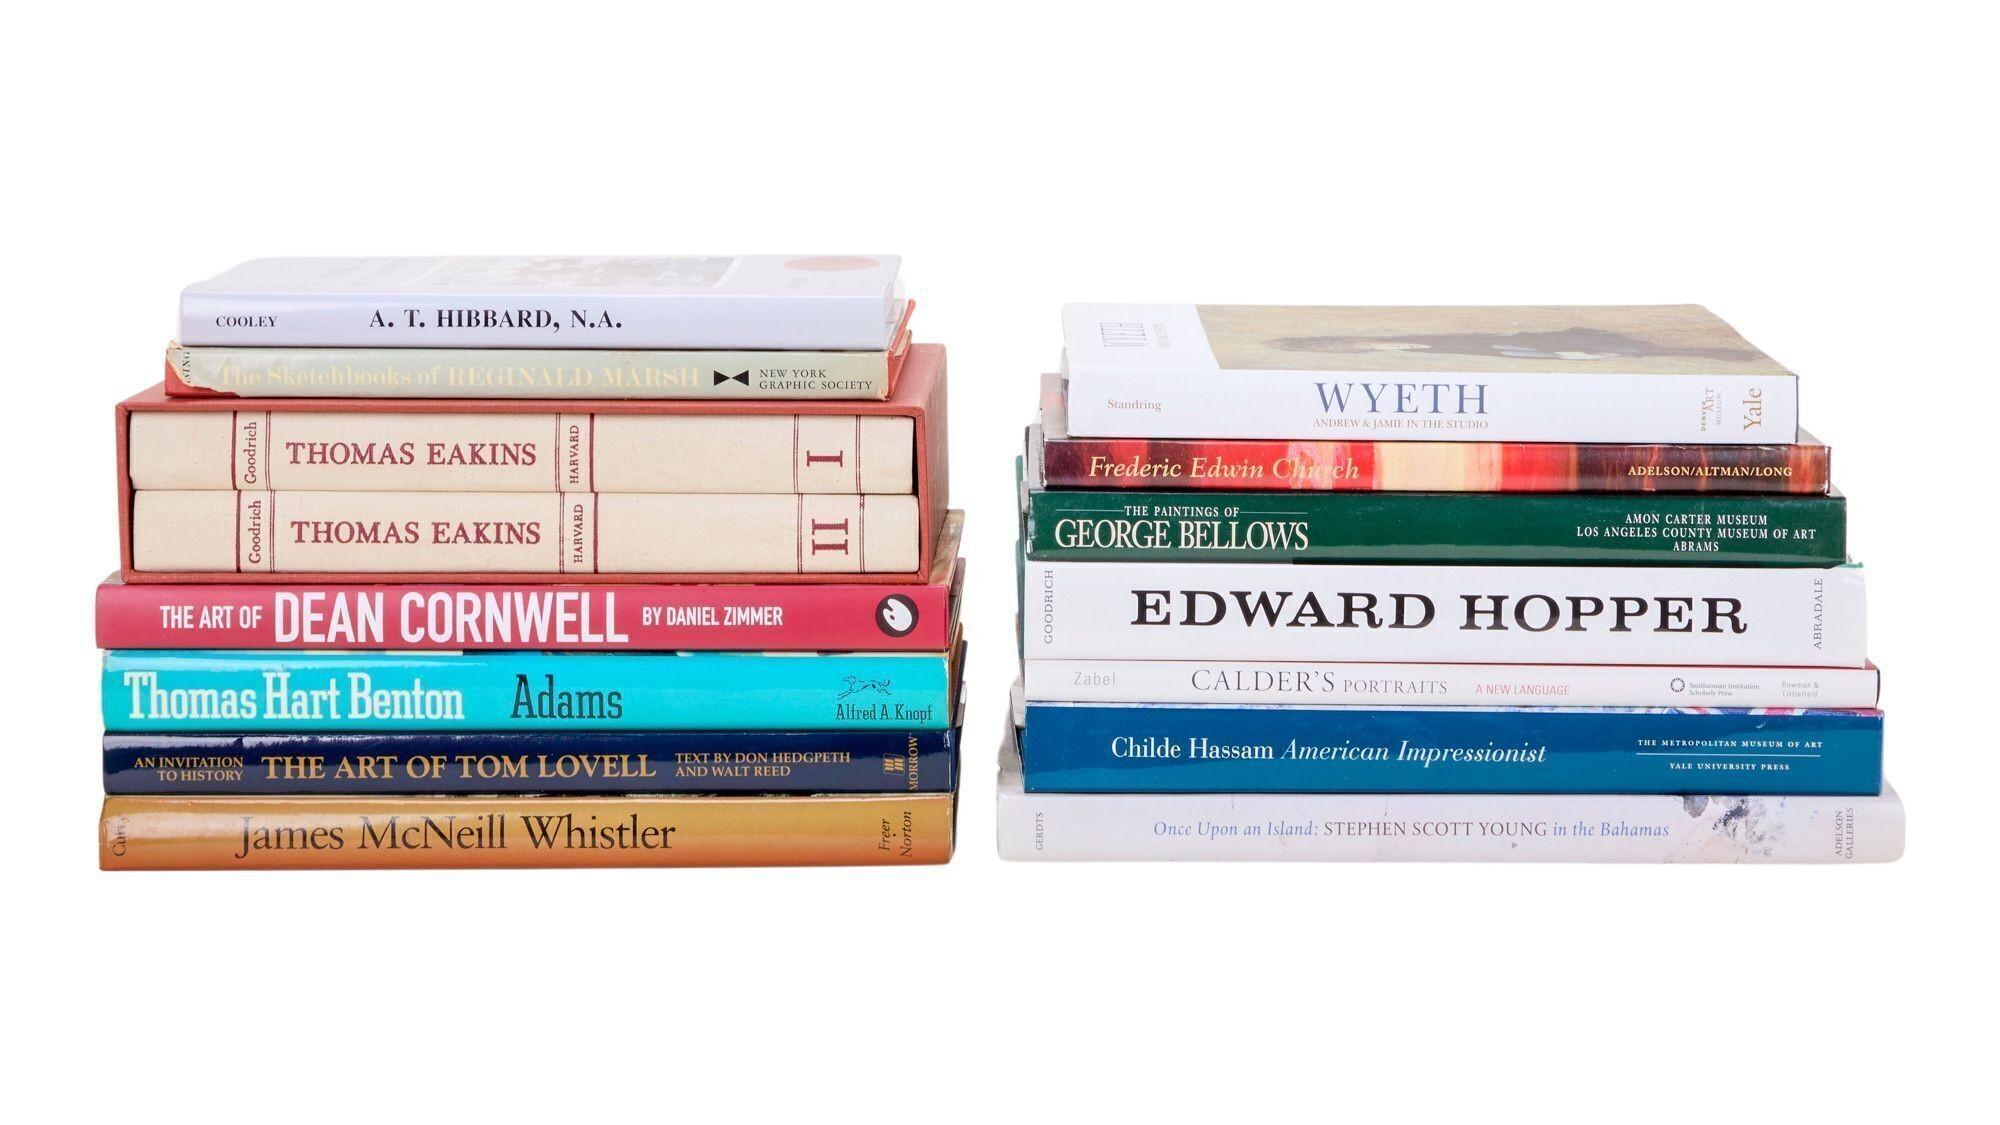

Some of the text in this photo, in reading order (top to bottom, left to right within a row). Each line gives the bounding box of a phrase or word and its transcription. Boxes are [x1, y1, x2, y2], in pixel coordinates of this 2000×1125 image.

[216, 316, 278, 327] COOLEY
[370, 309, 622, 333] A. T. HIBBARD, N.A.
[182, 351, 191, 384] NING
[219, 365, 700, 388] The Sketchbooks of REGINALD MARSH
[760, 369, 826, 378] NEW YORK
[760, 380, 872, 390] GRAPHIC SOCIETY
[1107, 399, 1162, 411] Standring
[1313, 382, 1489, 415] WYETH
[1706, 387, 1714, 412] ART
[1743, 388, 1762, 431] Yale
[1313, 418, 1488, 429] ANDREW & JAMIE IN THE STUDIO
[244, 421, 257, 484] Goodrich
[285, 442, 537, 466] THOMAS EAKINS
[569, 425, 579, 484] HARVARD
[1089, 456, 1359, 479] Frederic Edwin Church
[1628, 466, 1793, 477] ADELSON/ALTMAN/LONG
[1124, 506, 1240, 517] THE PAINTINGS OF
[1625, 514, 1768, 525] AMON CARTER MUSEUM
[248, 500, 262, 564] Goodrich
[290, 521, 542, 545] THOMAS EAKINS
[573, 504, 584, 563] HARVARD
[1055, 519, 1309, 551] GEORGE BELLOWS
[1577, 526, 1816, 539] LOS ANGELES COUNTY MUSEUM OF ART
[1673, 541, 1719, 552] ABRAMS
[160, 591, 783, 644] THE ART OF DEAN CORNWELL BY DANIEL ZIMMER
[1044, 569, 1054, 644] GOODRICH
[1131, 590, 1747, 633] EDWARD HOPPER
[1813, 578, 1823, 650] ABRADALE
[1073, 671, 1116, 685] Zabel
[1344, 679, 1448, 694] PORTRAITS
[1475, 684, 1570, 695] A NEW LANGUAGE
[124, 672, 624, 720] Thomas Hart Benton Adams
[1689, 689, 1715, 697] Scholarly
[835, 704, 932, 723] Alfred A. Knopf
[1111, 736, 1546, 766] Childe Hassam American Impressionist
[1741, 740, 1783, 748] MUSEUM
[134, 757, 244, 768] AN INVITATION
[262, 754, 656, 780] THE ART OF TOM LOVELL
[675, 751, 851, 763] TEXT BY DON HEDGPETH
[908, 736, 919, 791] MORROW
[157, 770, 244, 781] TO HISTORY
[676, 765, 791, 777] AND WALT REED
[236, 812, 676, 858] James McNeill Whistler
[878, 818, 891, 851] Freer
[899, 810, 912, 858] Norton
[1036, 812, 1044, 850] GERDTS
[1154, 821, 1669, 838] Once Upon an Island: STEPHEN SCOTT YOUNG in the Bahamas
[1845, 807, 1854, 859] GALLERIES
